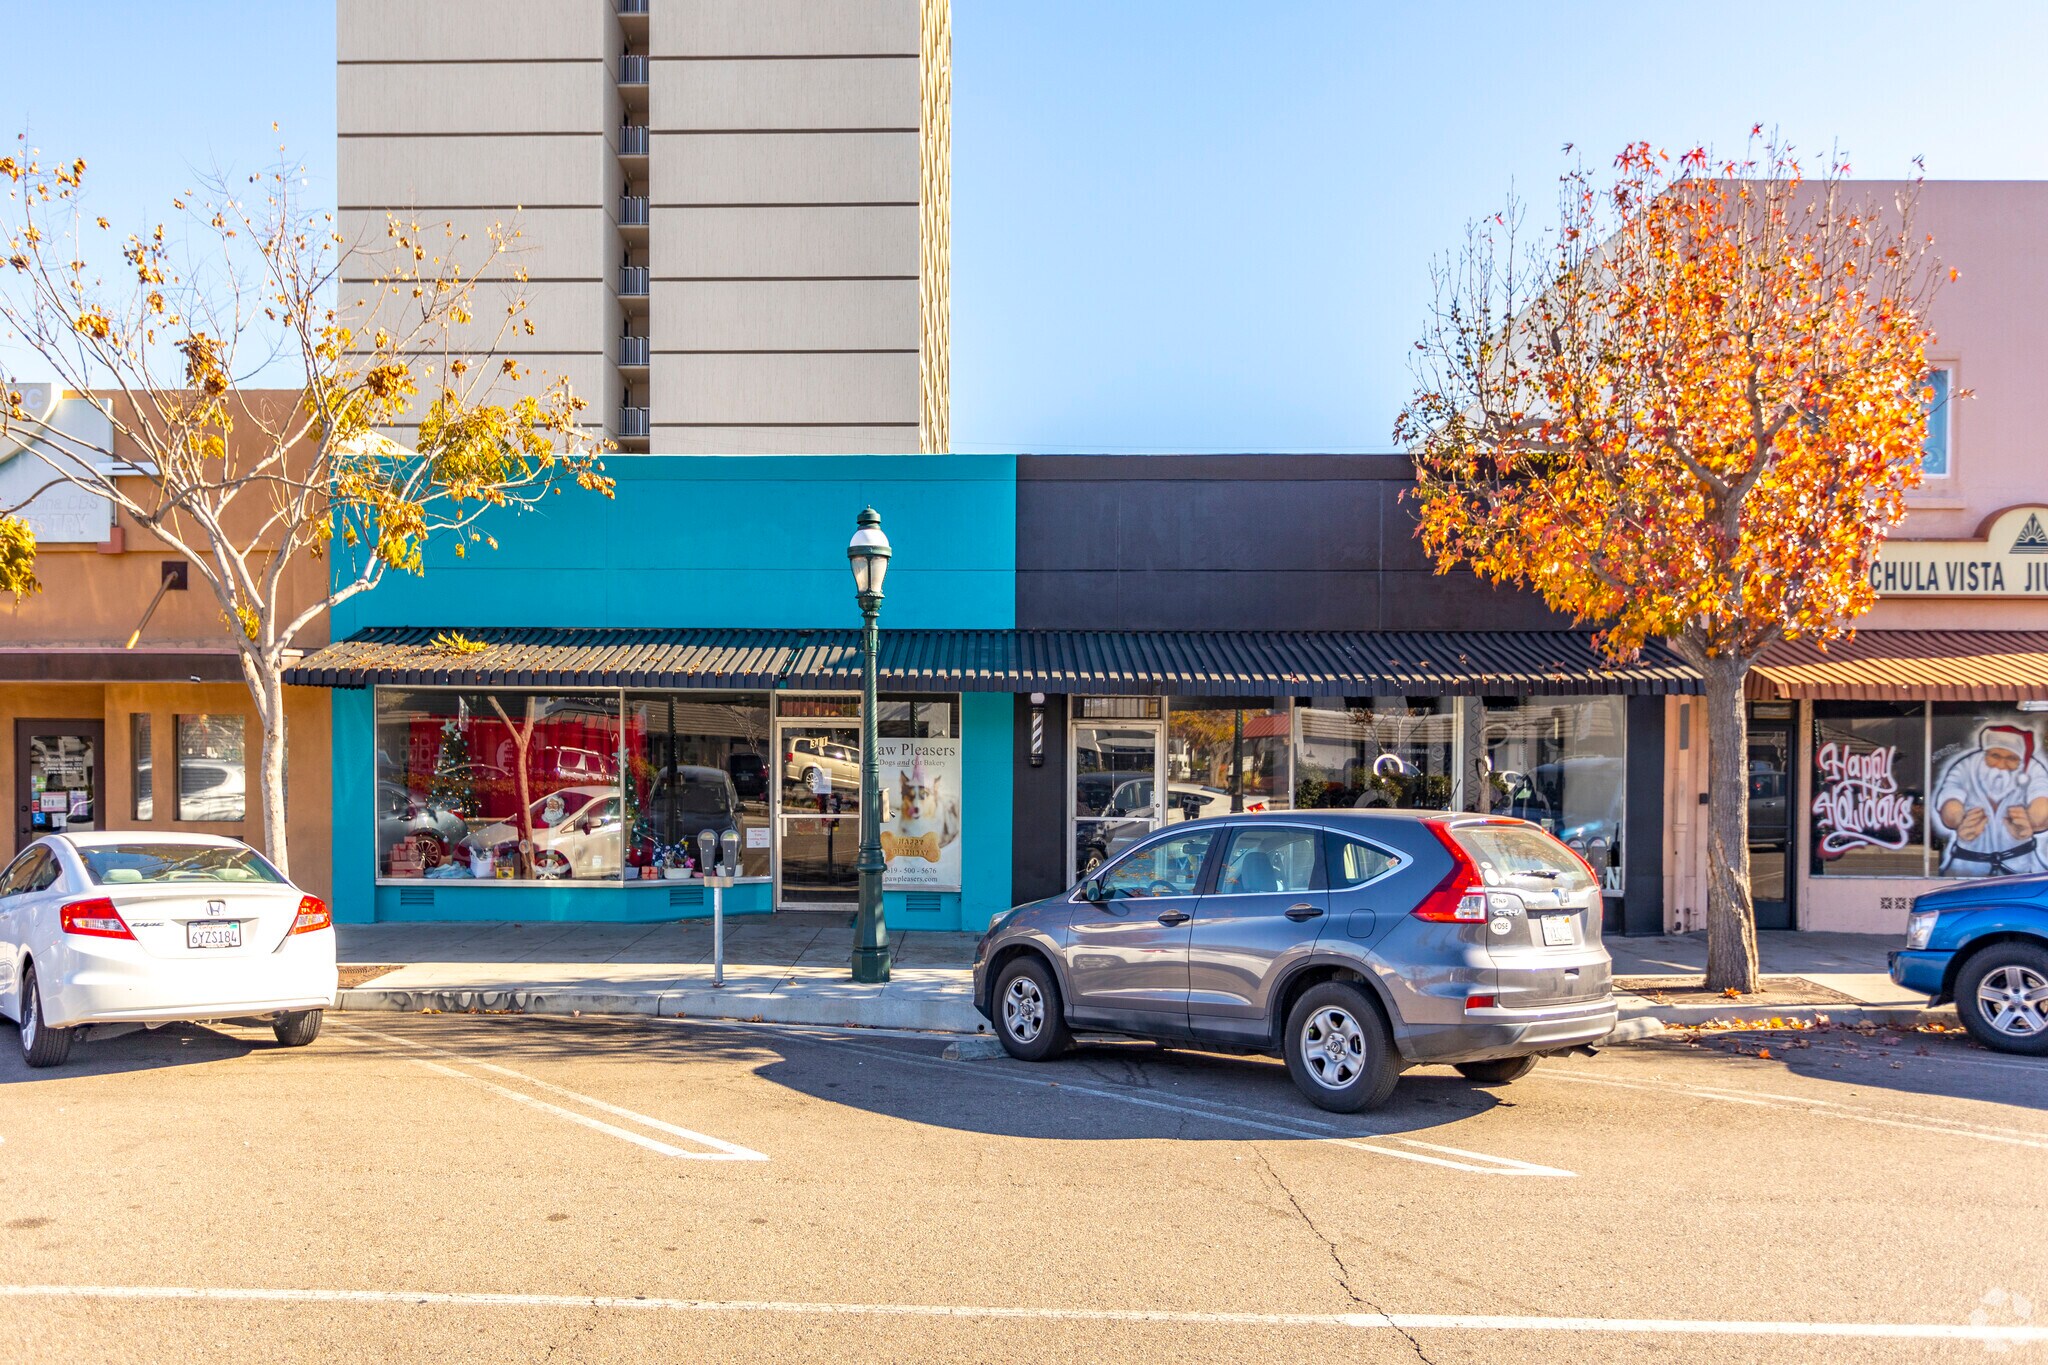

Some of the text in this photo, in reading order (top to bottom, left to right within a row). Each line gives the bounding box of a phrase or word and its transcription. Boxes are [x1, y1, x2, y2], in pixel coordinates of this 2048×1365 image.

[1870, 561, 1939, 591] CHULA
[1946, 561, 2005, 591] VISTA
[878, 743, 956, 756] aw Pleasers
[879, 759, 896, 768] Dogs
[896, 759, 911, 767] and
[1816, 742, 1898, 796] Happy
[1493, 922, 1509, 930] YOSE
[192, 930, 237, 944] 6YZS184
